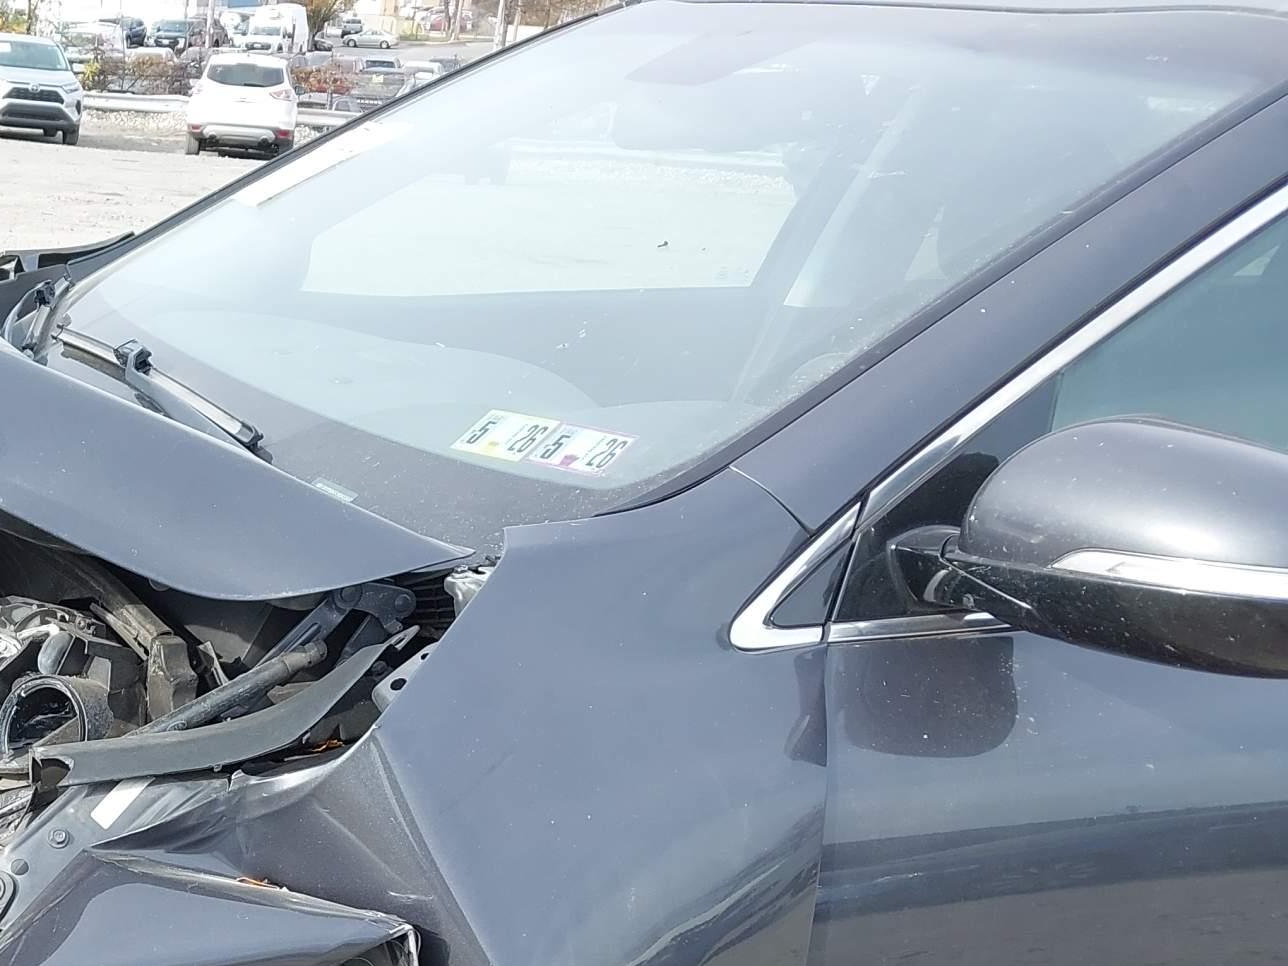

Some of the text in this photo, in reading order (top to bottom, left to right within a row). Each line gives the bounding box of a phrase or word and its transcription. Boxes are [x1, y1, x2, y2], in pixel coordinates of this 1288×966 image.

[466, 420, 549, 453] 5 26
[539, 434, 628, 469] 5 26
